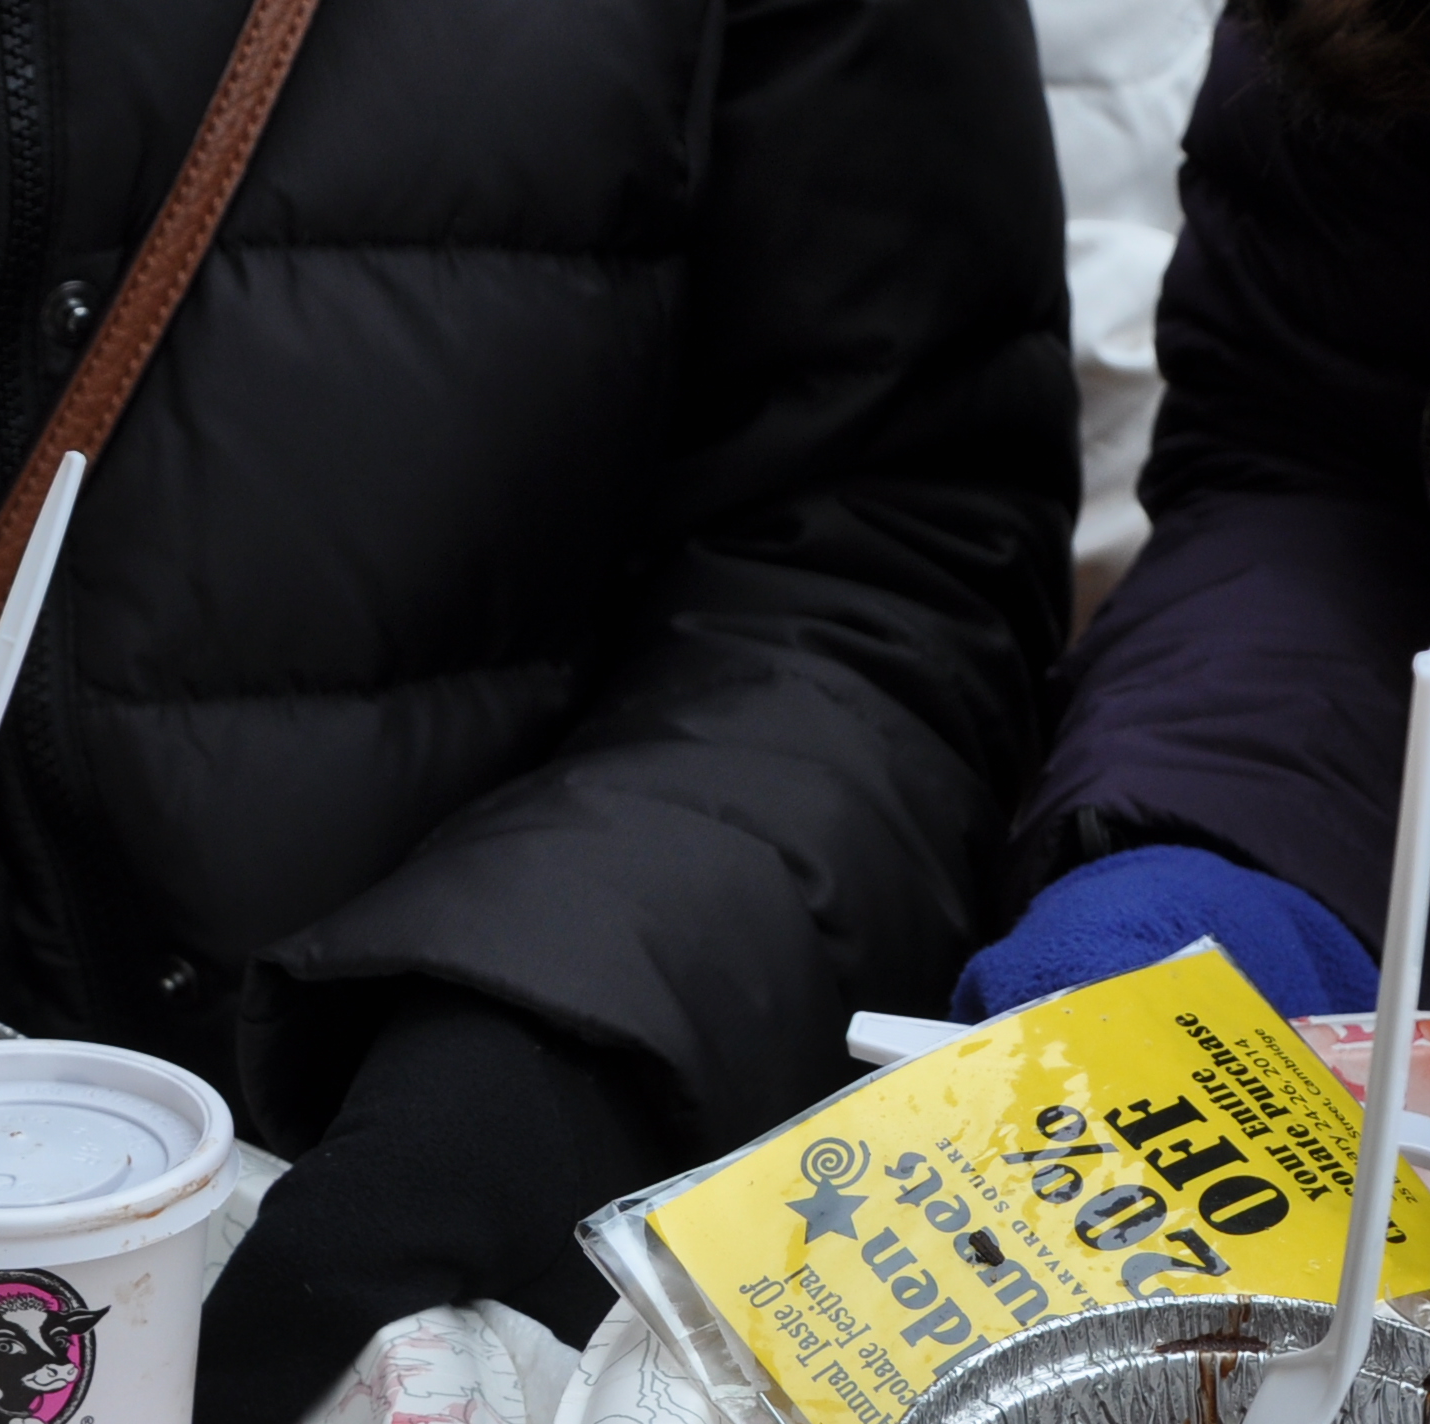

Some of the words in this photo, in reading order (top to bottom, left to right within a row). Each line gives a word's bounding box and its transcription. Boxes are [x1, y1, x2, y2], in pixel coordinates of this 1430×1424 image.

[1175, 1012, 1292, 1123] Purchase
[1234, 1038, 1282, 1079] 2014
[1254, 1028, 1322, 1096] Cambridge
[1191, 1067, 1274, 1140] Entire
[1279, 1080, 1333, 1132] 24-26,
[935, 1137, 1010, 1213] SQUARE
[1103, 1094, 1290, 1236] OFF
[1264, 1143, 1333, 1203] Your
[1398, 1187, 1418, 1204] 25
[999, 1104, 1232, 1301] 20%
[884, 1152, 1063, 1327] weets
[1011, 1219, 1098, 1312] HARVARD
[739, 1275, 786, 1309] Of
[783, 1263, 872, 1349] Festival
[774, 1304, 832, 1368] Taste
[858, 1342, 917, 1407] colate
